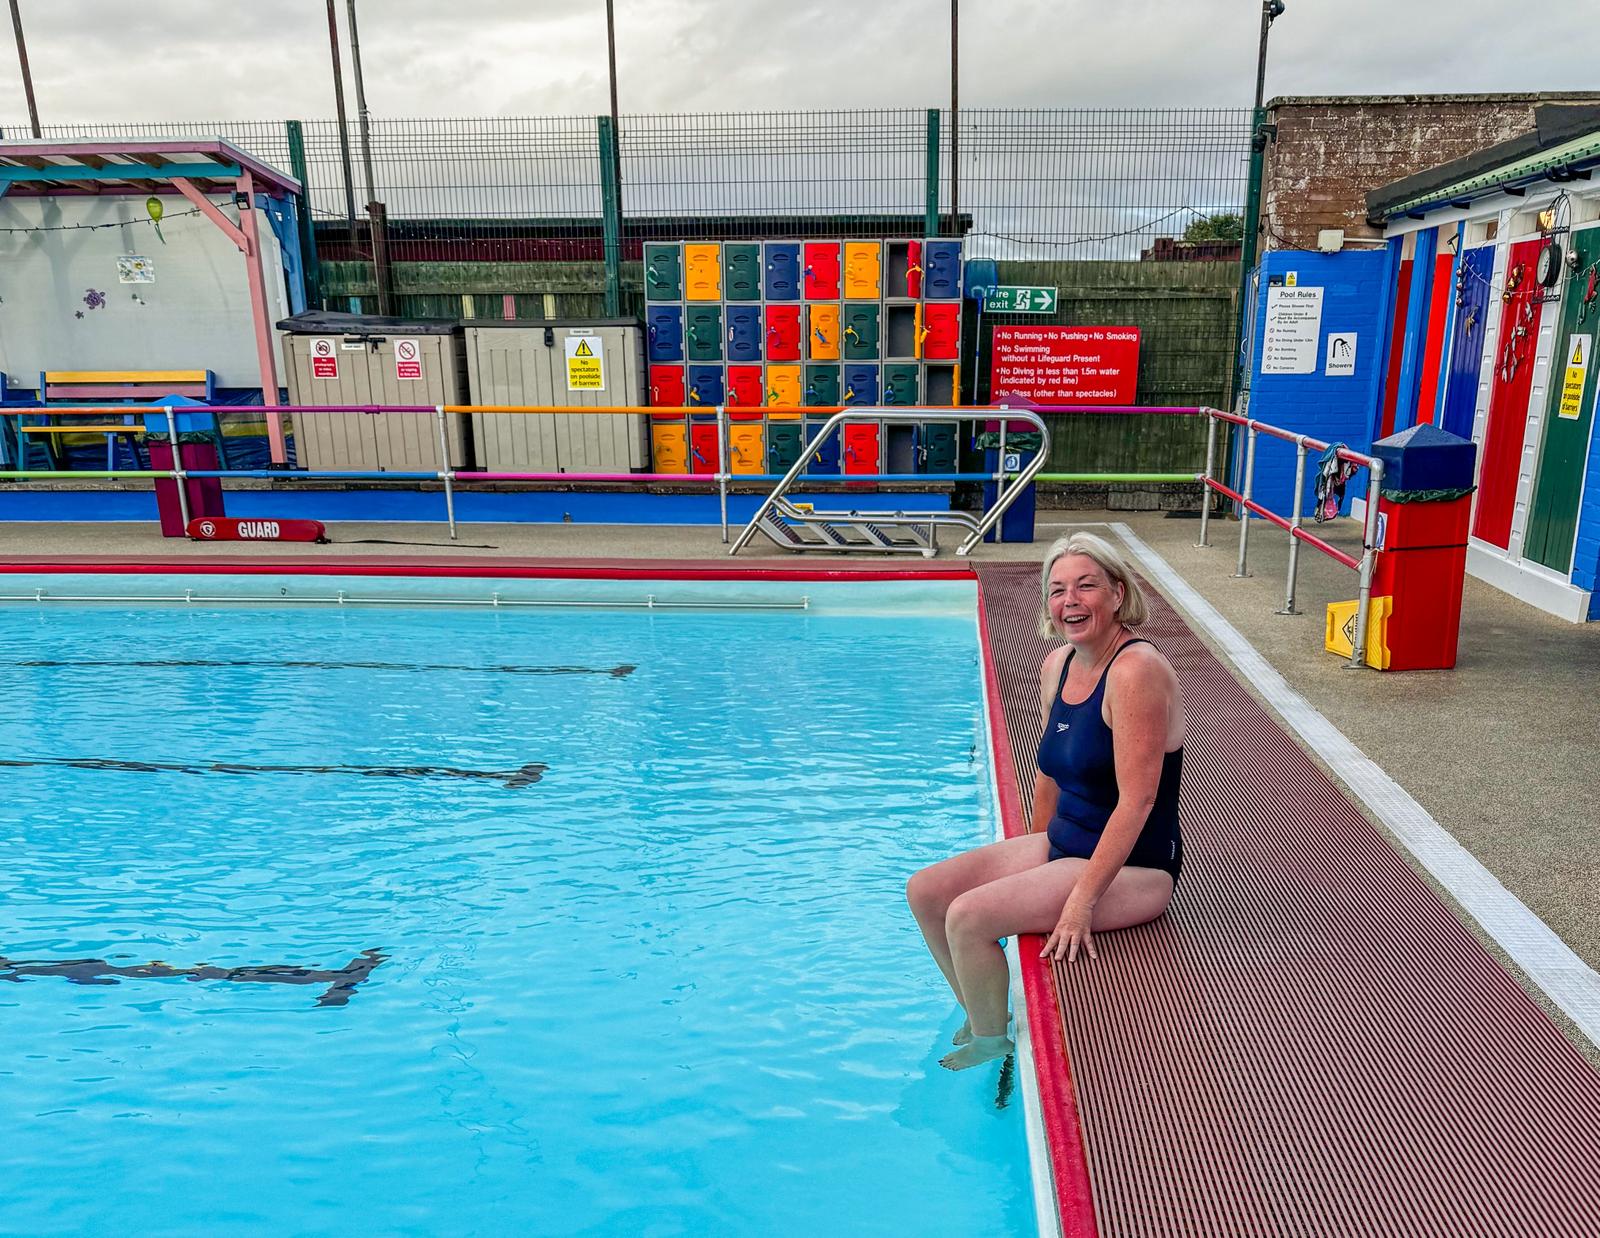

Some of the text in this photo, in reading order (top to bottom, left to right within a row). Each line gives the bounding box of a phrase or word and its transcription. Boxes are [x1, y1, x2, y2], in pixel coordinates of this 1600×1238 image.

[990, 300, 1008, 308] exit
[1014, 332, 1042, 341] Running
[1061, 332, 1088, 341] Pushing
[1106, 332, 1137, 341] Smoking
[1038, 355, 1070, 363] Lifeguard
[1013, 368, 1034, 376] Diving
[1038, 377, 1046, 386] by
[238, 522, 280, 538] GUARD
